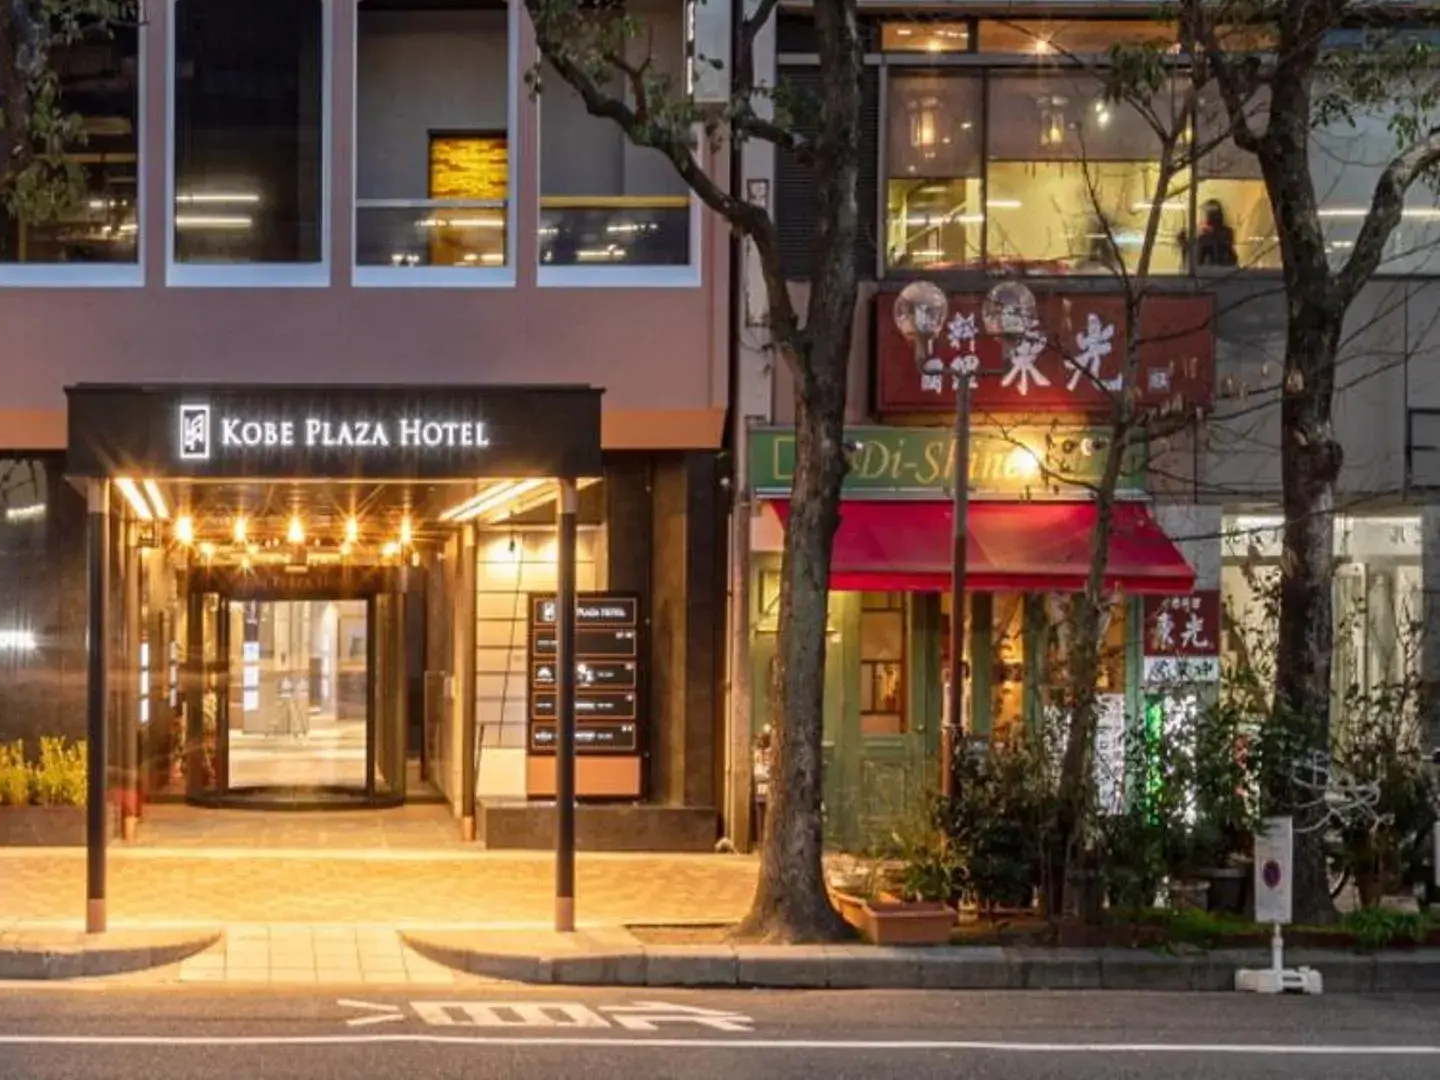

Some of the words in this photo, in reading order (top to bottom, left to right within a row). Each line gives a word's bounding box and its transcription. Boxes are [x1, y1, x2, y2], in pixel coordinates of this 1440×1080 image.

[221, 418, 294, 446] KOBE
[305, 418, 390, 446] PLAZA
[400, 419, 490, 446] HOTEL
